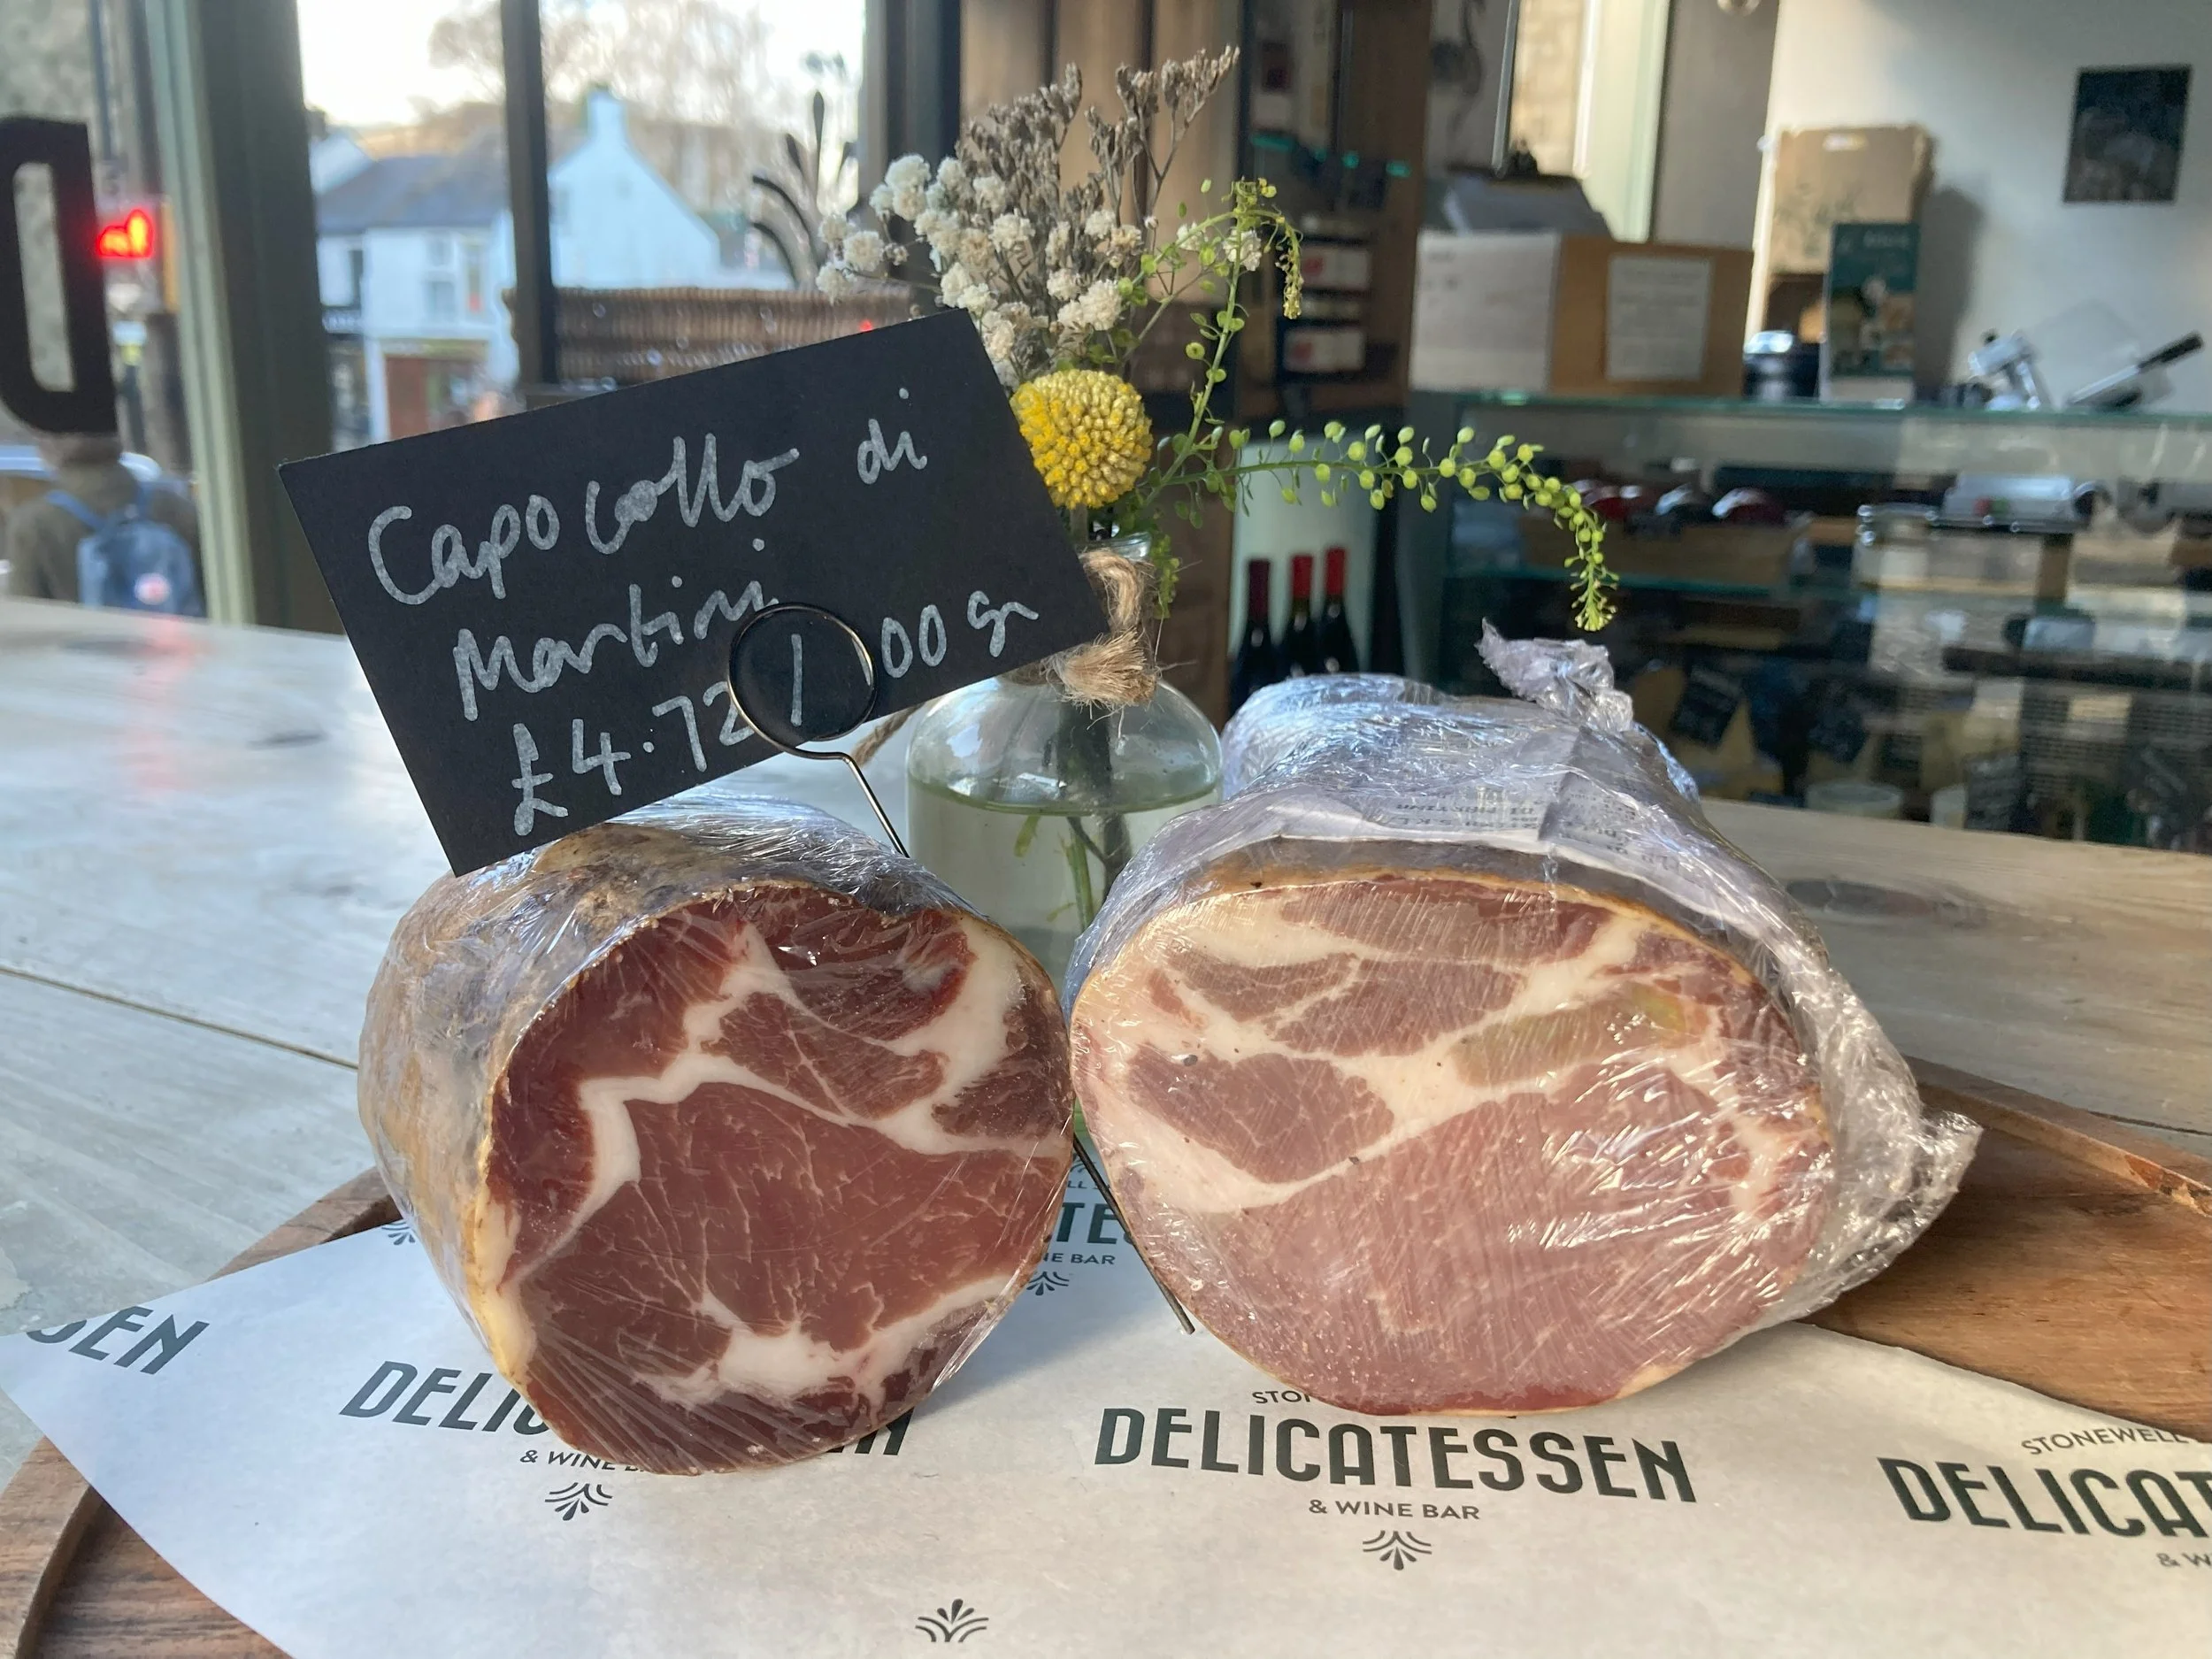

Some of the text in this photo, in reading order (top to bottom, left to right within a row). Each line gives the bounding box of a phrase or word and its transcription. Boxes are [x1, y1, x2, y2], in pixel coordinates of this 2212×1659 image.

[856, 387, 928, 486] di
[1056, 1202, 1134, 1245] TE
[1071, 1254, 1115, 1264] BAR
[1094, 1407, 1697, 1502] DELICATESSEN
[1309, 1499, 1480, 1520] & WINE BAR
